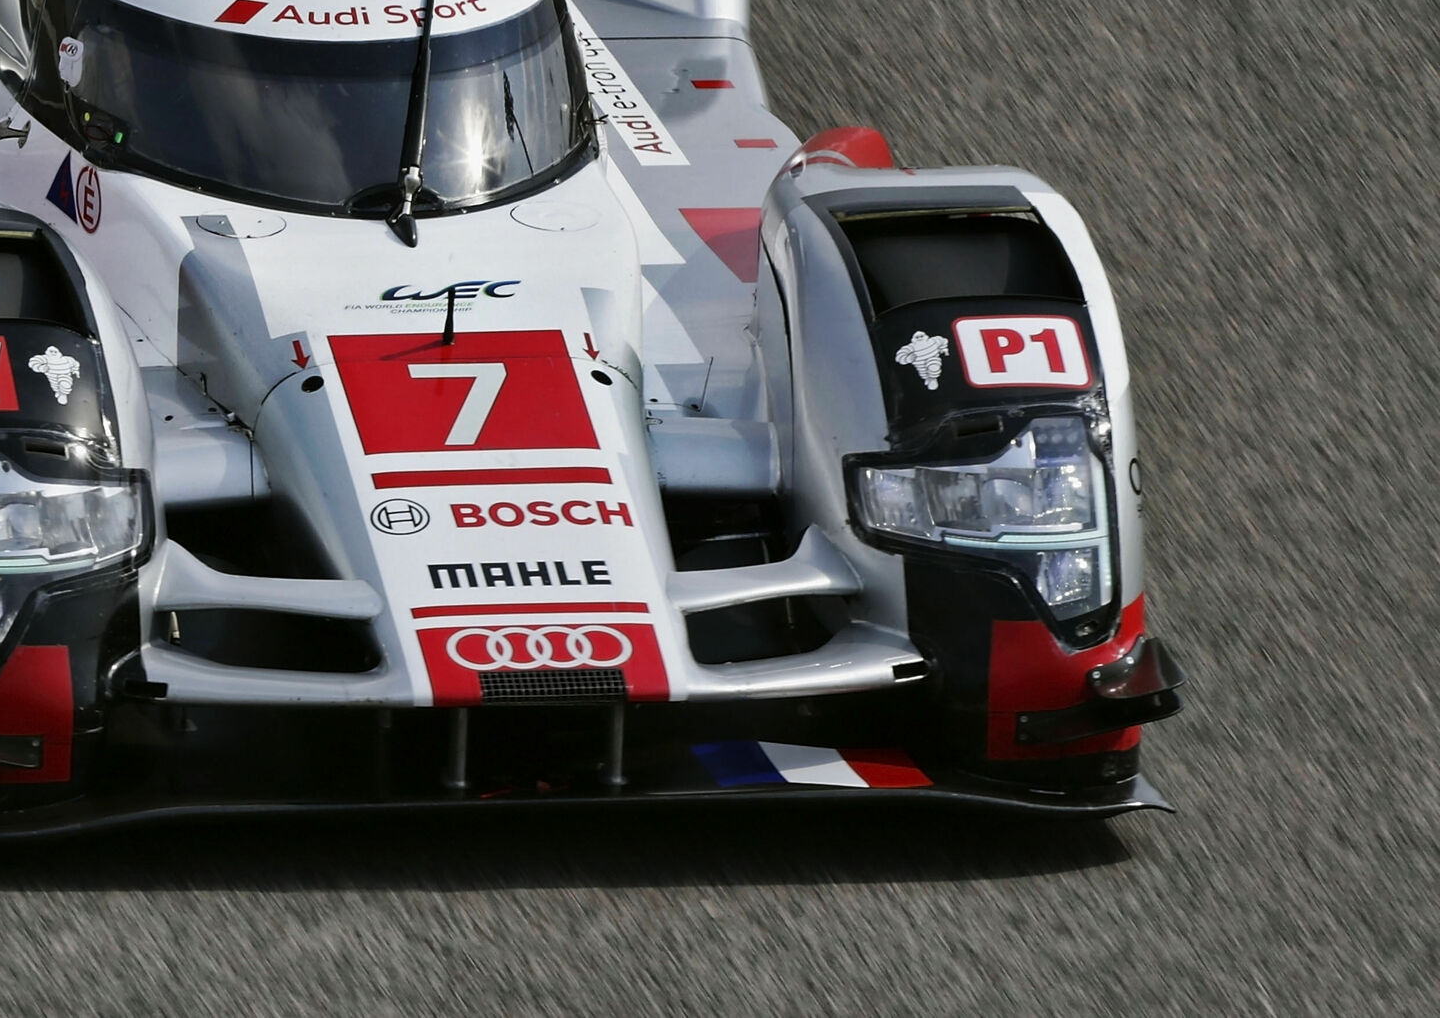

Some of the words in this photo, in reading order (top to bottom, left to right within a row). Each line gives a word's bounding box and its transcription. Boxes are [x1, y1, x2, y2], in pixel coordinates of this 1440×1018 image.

[273, 4, 369, 26] Audi
[584, 62, 638, 110] e-tron
[613, 114, 672, 155] Audi
[380, 280, 521, 301] WEC
[980, 328, 1065, 373] P1
[407, 362, 508, 446] 7
[450, 500, 634, 529] BOSCH
[428, 560, 612, 589] MAHLE
